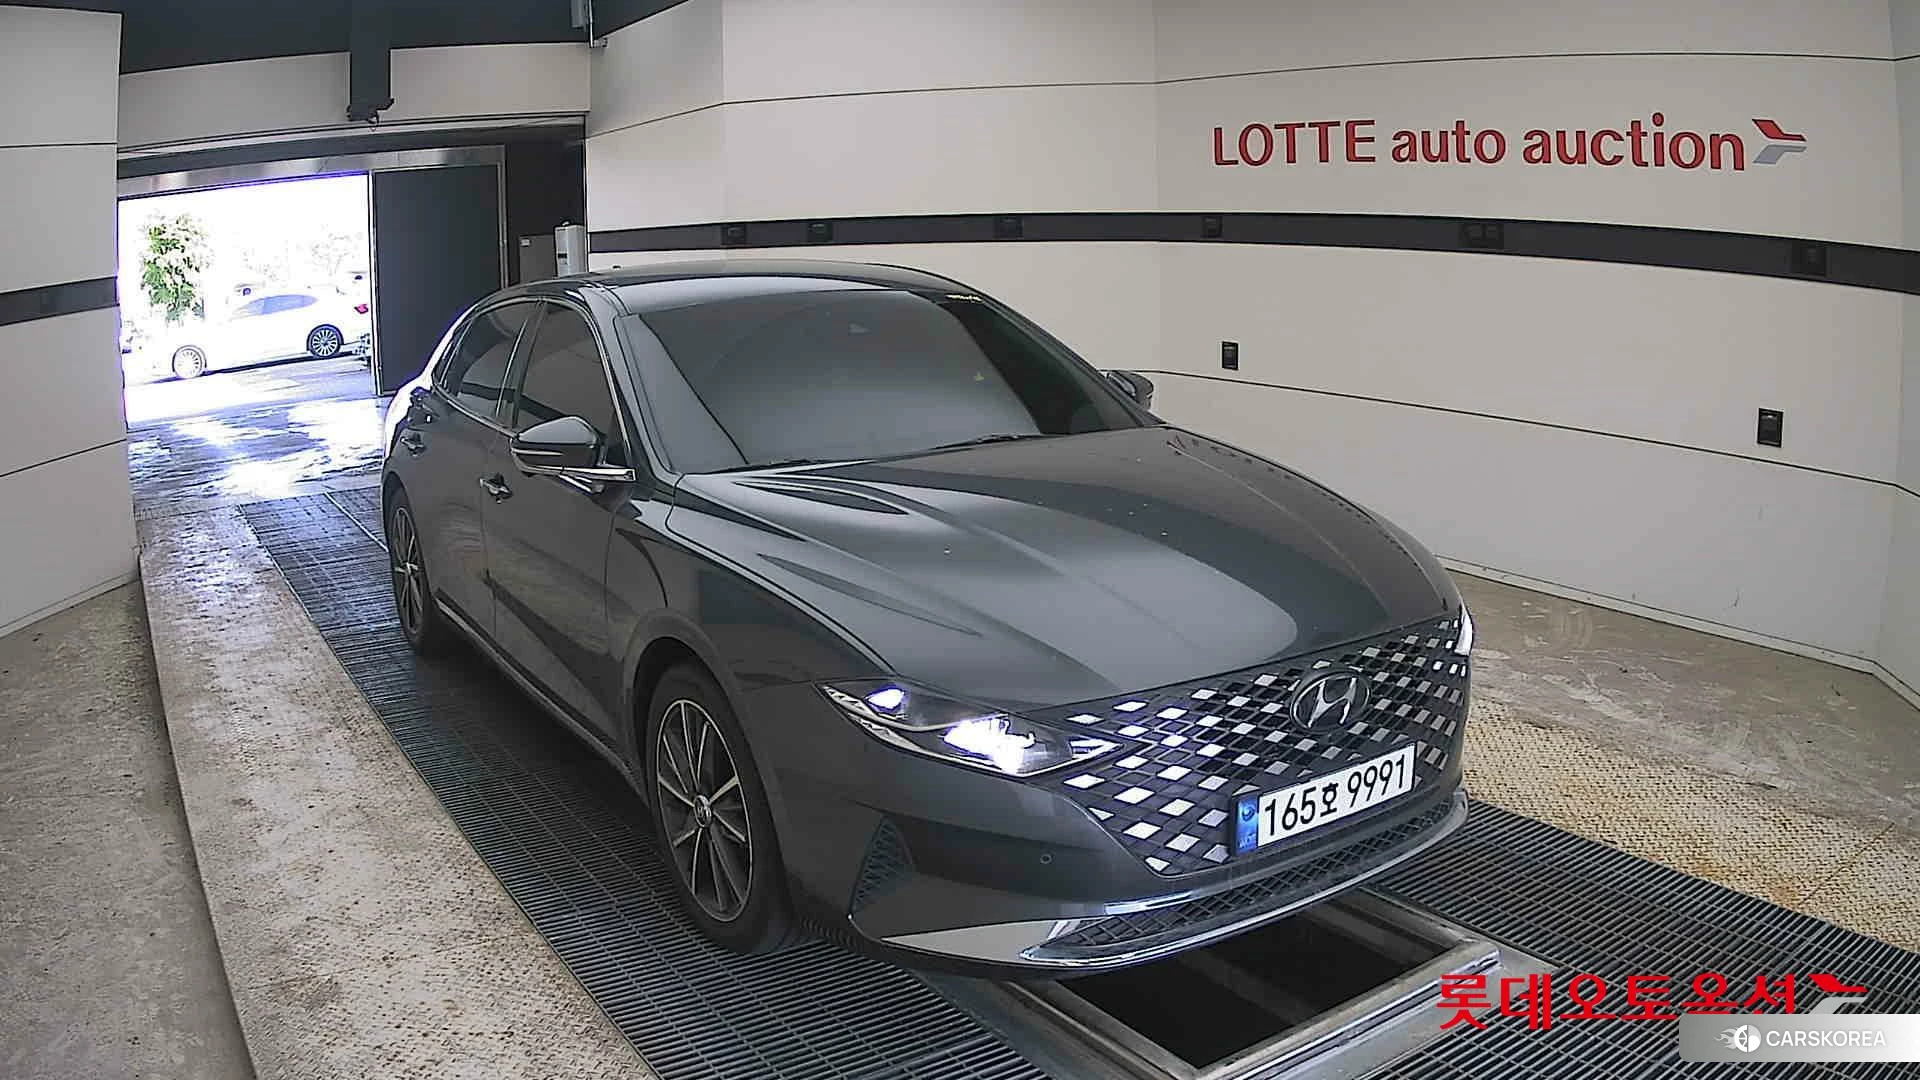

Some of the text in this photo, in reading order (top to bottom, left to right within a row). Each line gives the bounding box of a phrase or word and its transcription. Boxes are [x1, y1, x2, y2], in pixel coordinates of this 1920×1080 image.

[1213, 112, 1745, 171] LOTTE auto auction
[1264, 754, 1405, 836] 165호 9991
